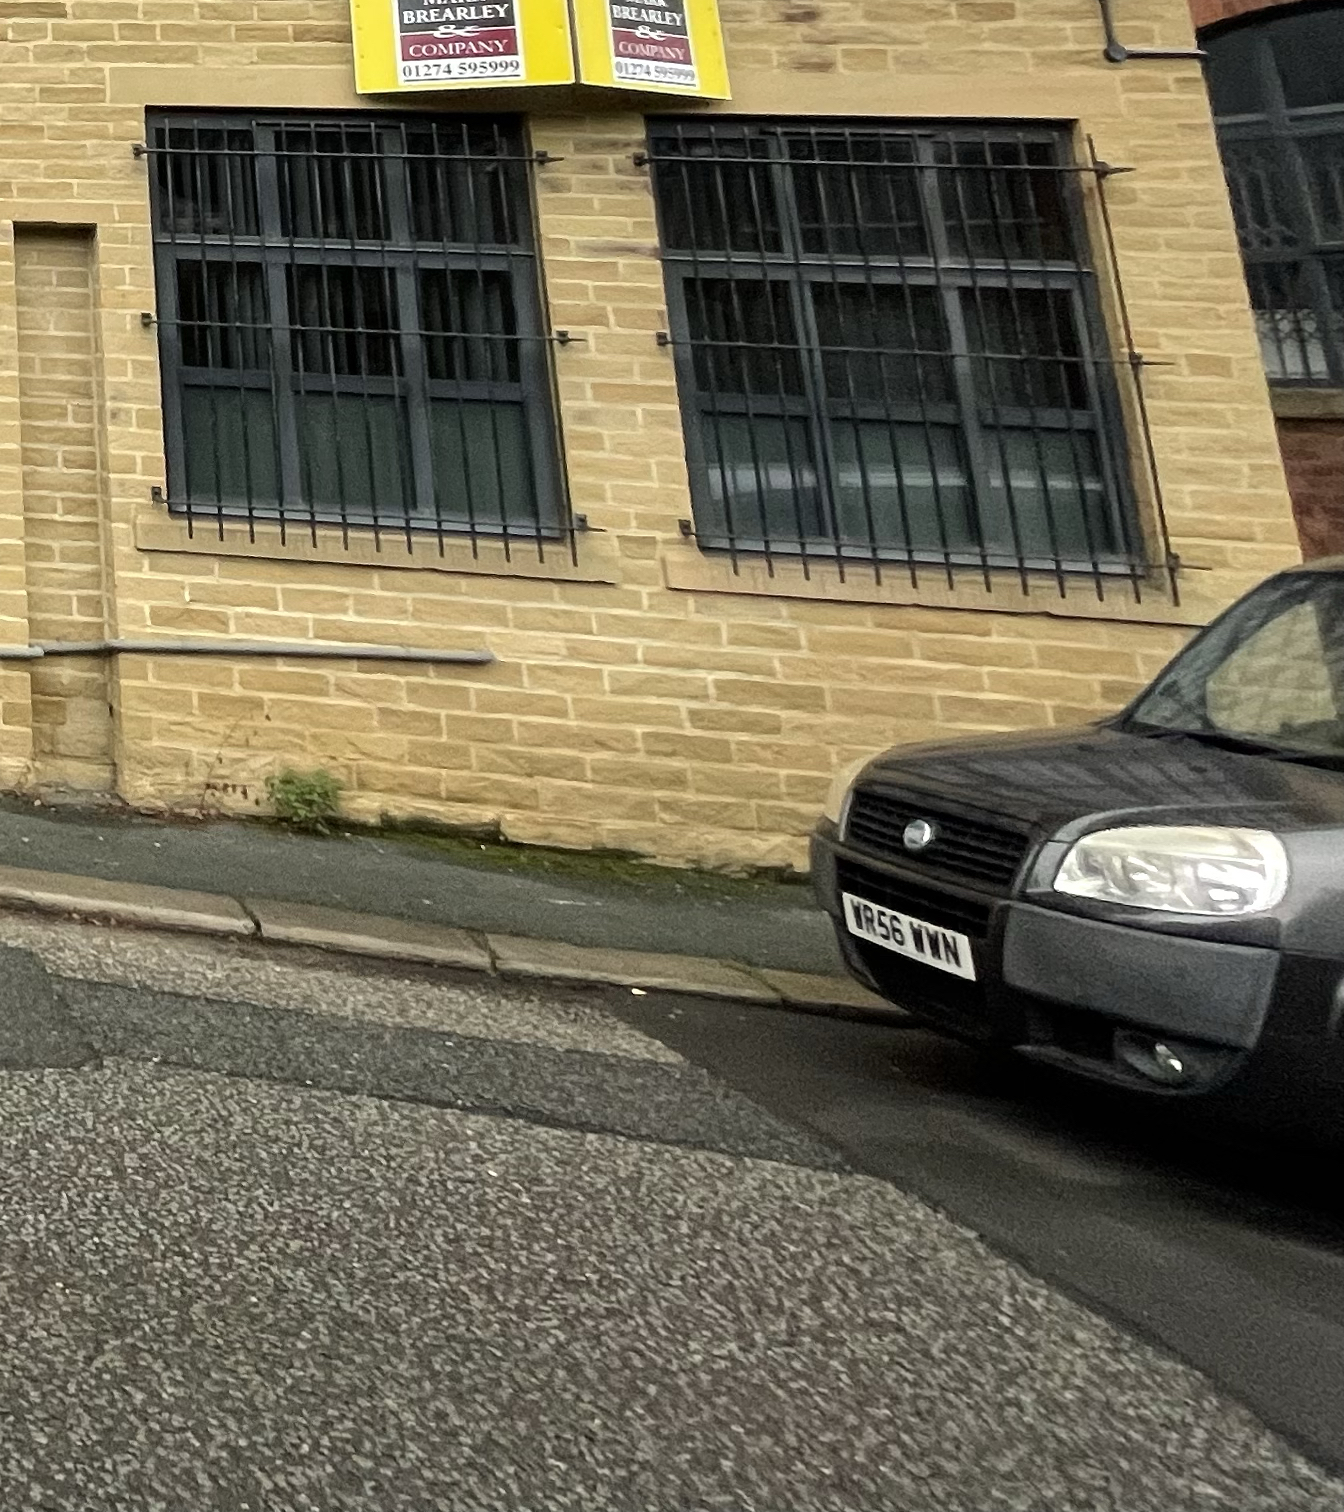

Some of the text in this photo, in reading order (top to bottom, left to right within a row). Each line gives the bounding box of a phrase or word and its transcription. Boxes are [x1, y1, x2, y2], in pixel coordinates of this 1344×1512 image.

[402, 3, 509, 24] BREARLEY
[611, 4, 683, 26] BREARLEY
[433, 24, 481, 39] &
[635, 25, 667, 41] &
[409, 39, 509, 57] COMPANY
[618, 41, 686, 61] COMPANY
[402, 59, 520, 78] 01274 595999
[615, 61, 652, 77] 01274
[850, 898, 906, 947] WR56
